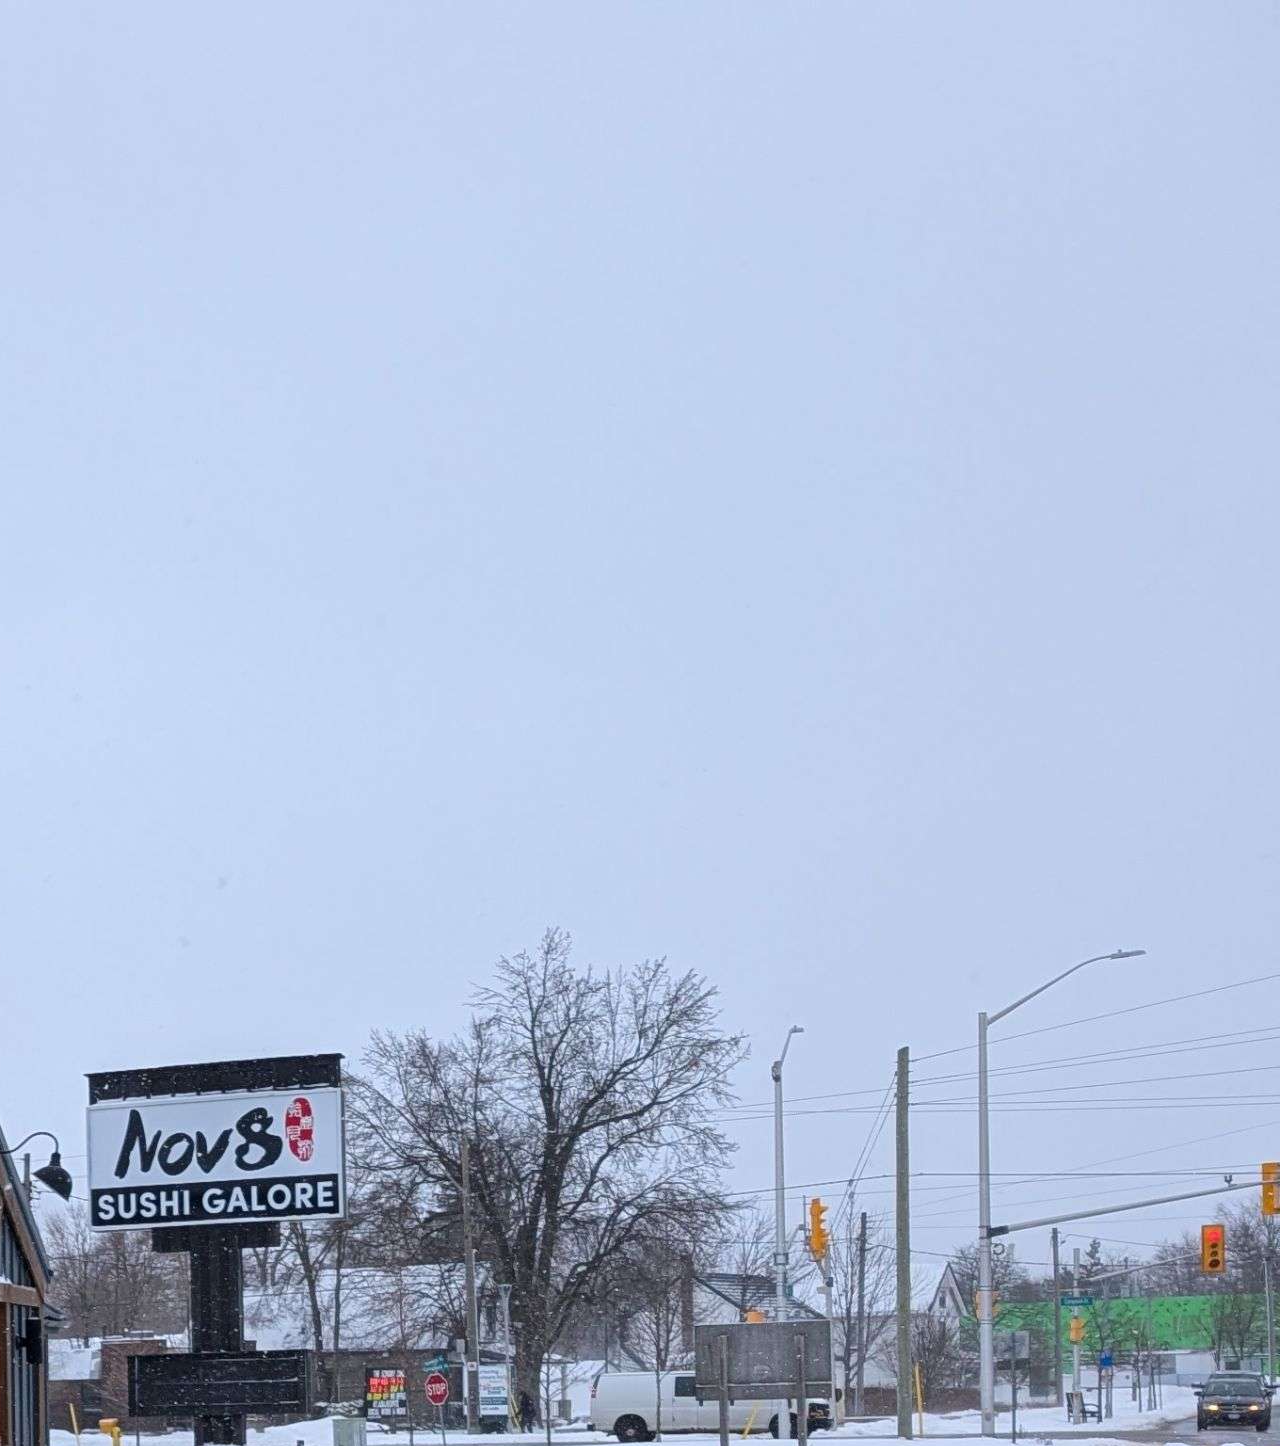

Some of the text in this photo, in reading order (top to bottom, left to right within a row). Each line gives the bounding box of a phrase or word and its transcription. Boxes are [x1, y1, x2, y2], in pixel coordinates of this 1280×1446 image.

[98, 1180, 334, 1220] SUSHI GALORE
[427, 1383, 446, 1396] STOP
